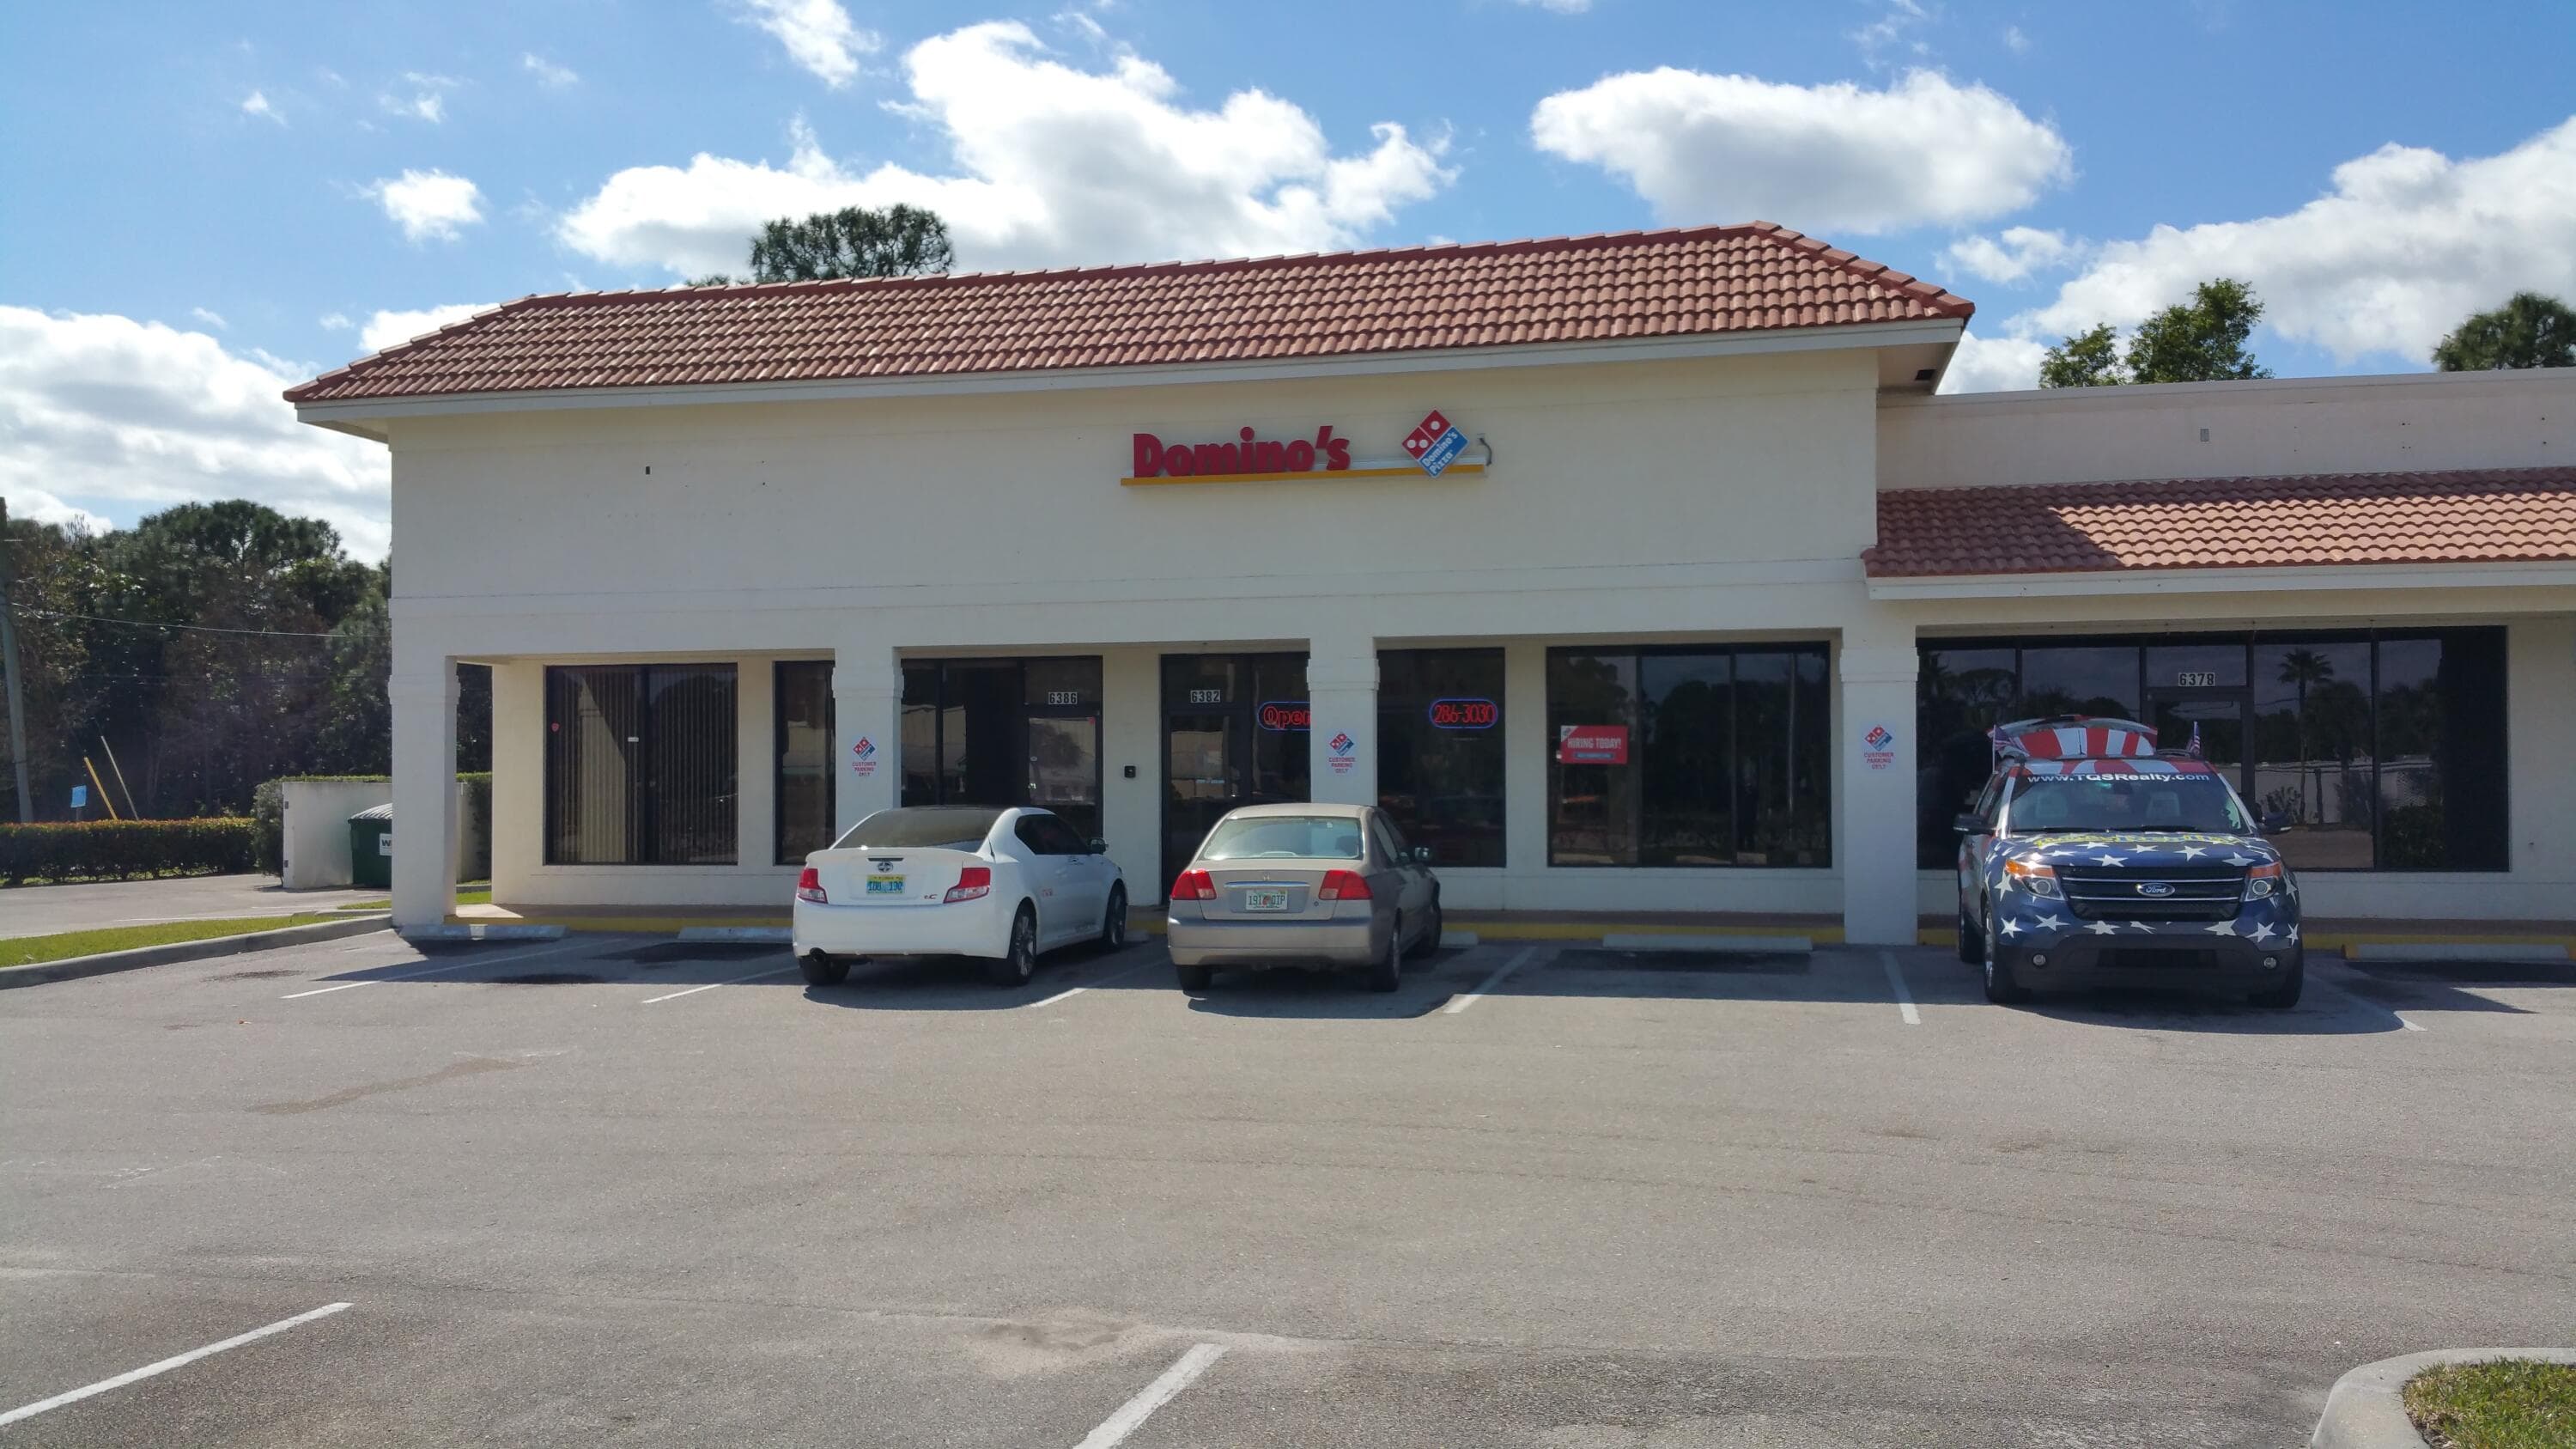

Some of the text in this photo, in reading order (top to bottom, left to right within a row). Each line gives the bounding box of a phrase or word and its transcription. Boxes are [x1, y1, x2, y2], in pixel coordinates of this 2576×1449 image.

[1133, 425, 1351, 478] Domino's
[1422, 432, 1458, 466] Domino's
[1430, 451, 1454, 474] Pizza
[2179, 673, 2215, 685] 6378
[1049, 692, 1078, 703] 6386
[1191, 691, 1220, 703] 6382
[1434, 703, 1496, 723] 286-3030
[1567, 737, 1621, 749] HIRING TODAY!
[2027, 773, 2210, 783] www.TQSRealty.com
